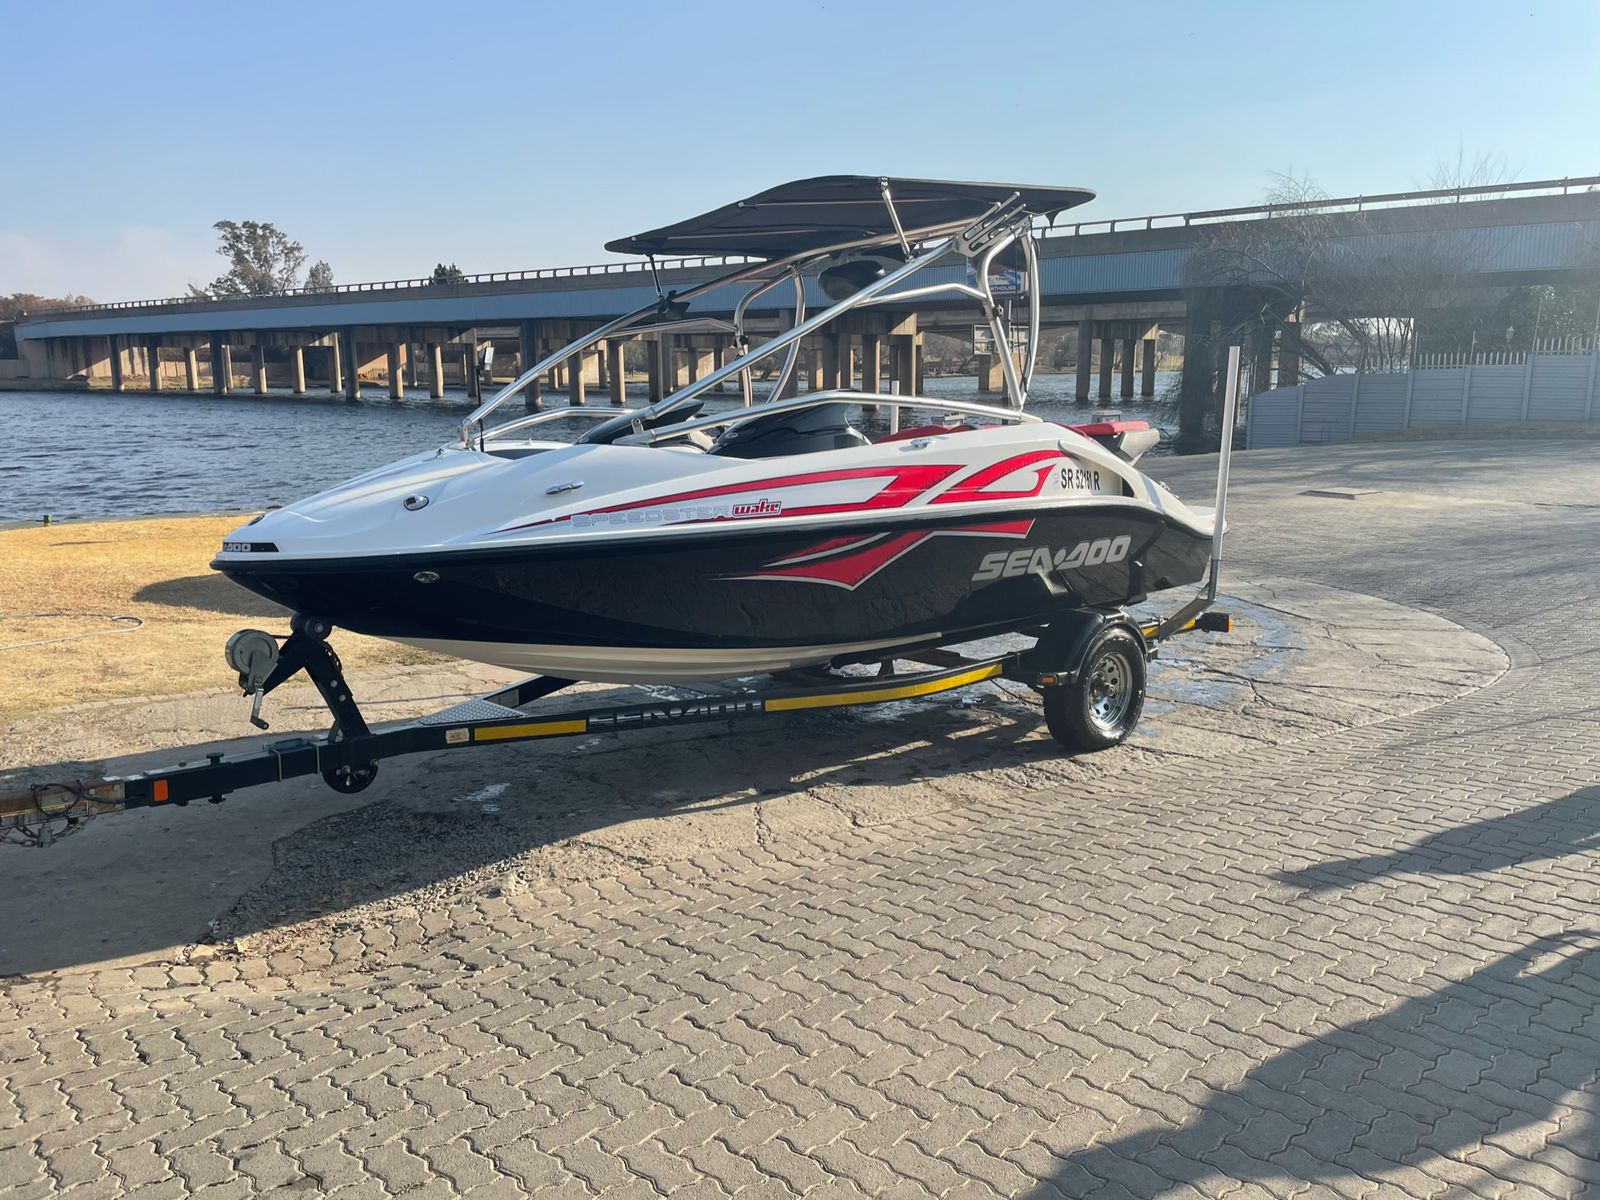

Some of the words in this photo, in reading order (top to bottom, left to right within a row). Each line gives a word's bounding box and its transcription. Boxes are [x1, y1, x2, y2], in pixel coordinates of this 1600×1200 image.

[1061, 468, 1074, 489] SR
[1093, 470, 1101, 490] R
[571, 504, 730, 527] SPEEDSTER
[733, 500, 781, 516] wake
